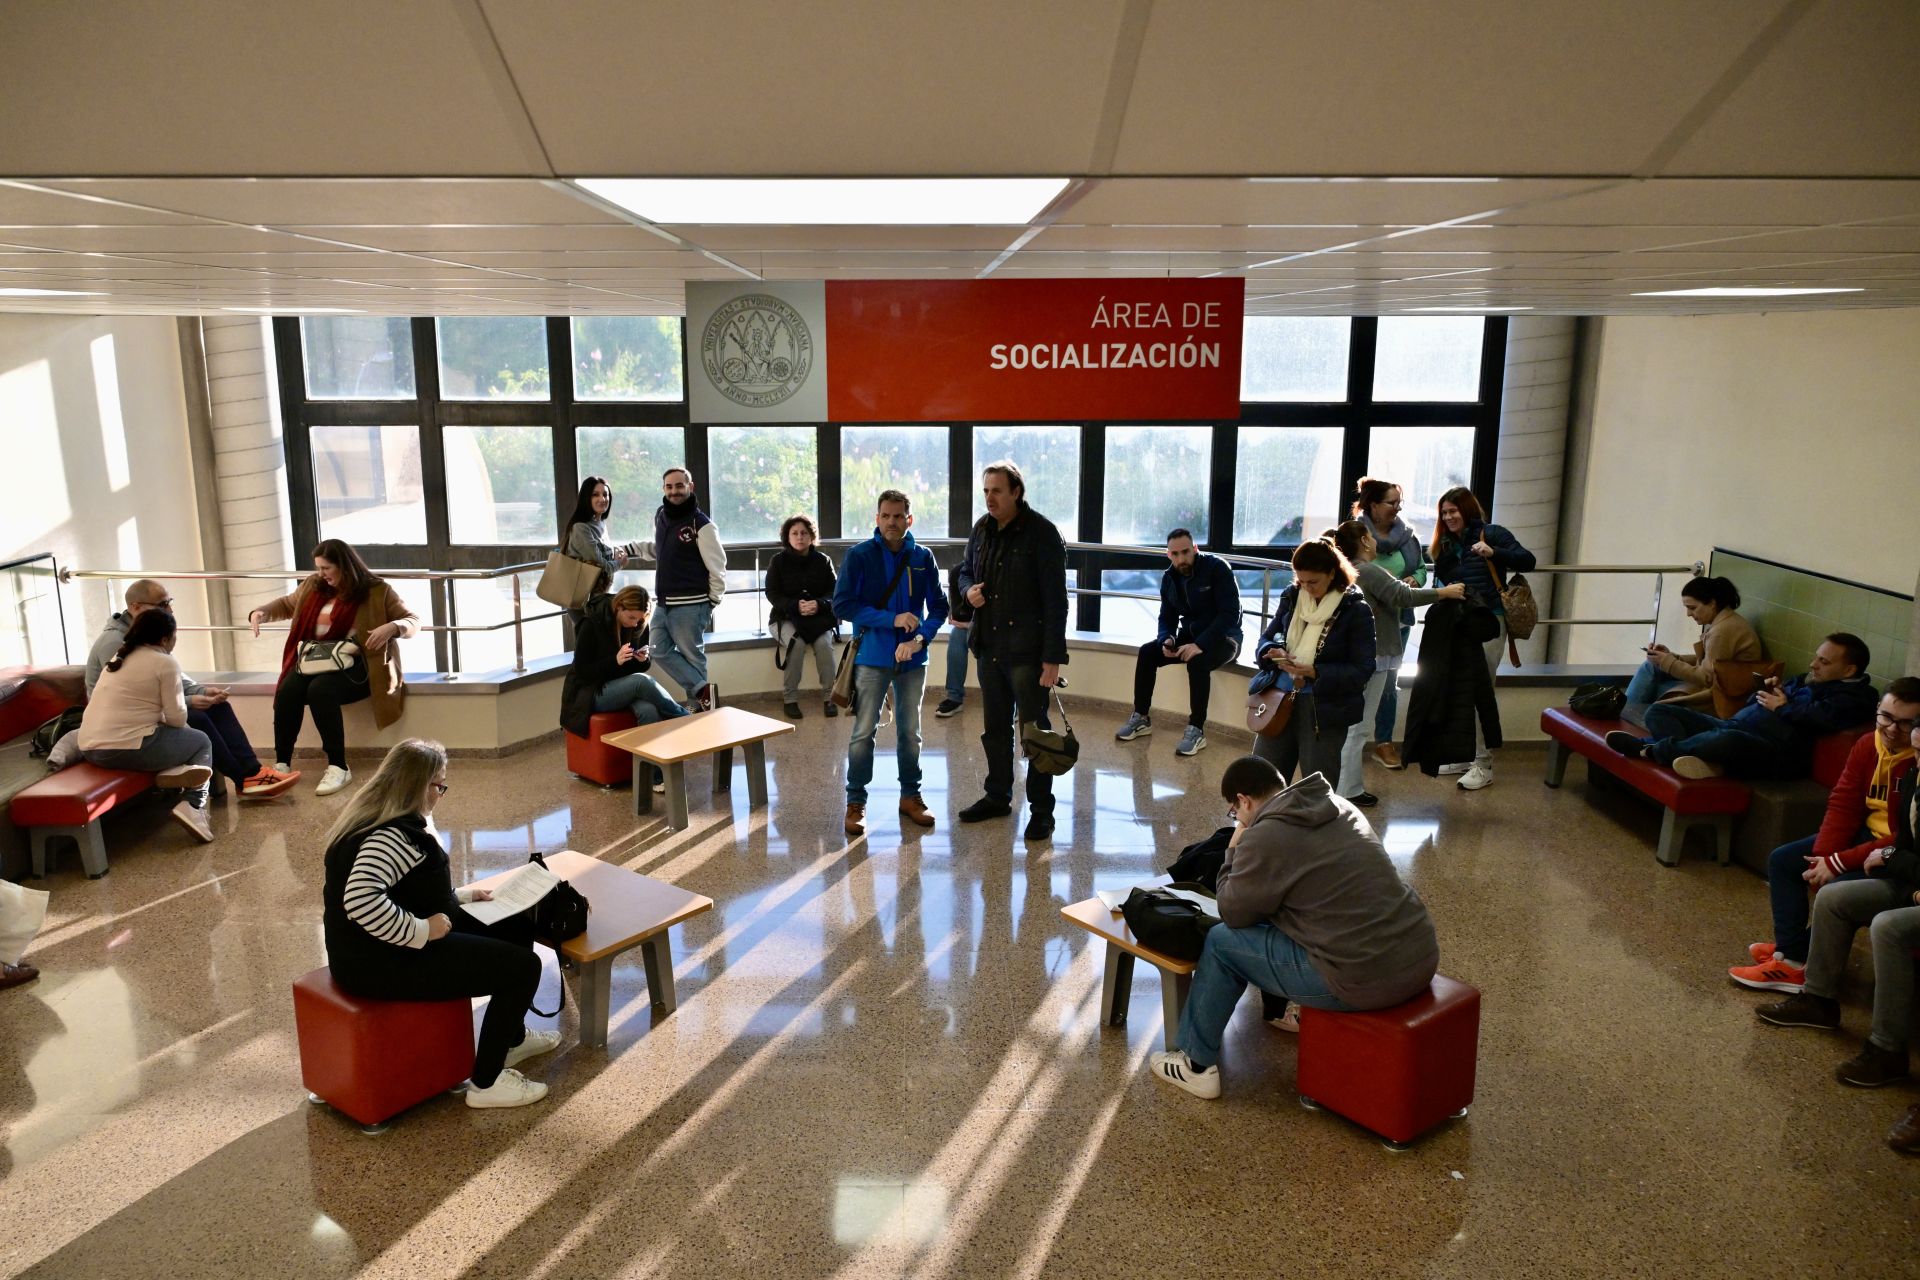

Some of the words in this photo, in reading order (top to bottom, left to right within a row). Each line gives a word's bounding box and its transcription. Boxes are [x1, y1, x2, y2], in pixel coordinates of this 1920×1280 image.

[1091, 296, 1172, 328] ÁREA
[1182, 302, 1221, 328] DE
[990, 335, 1220, 370] SOCIALIZACIÓN
[723, 385, 748, 402] ANNO
